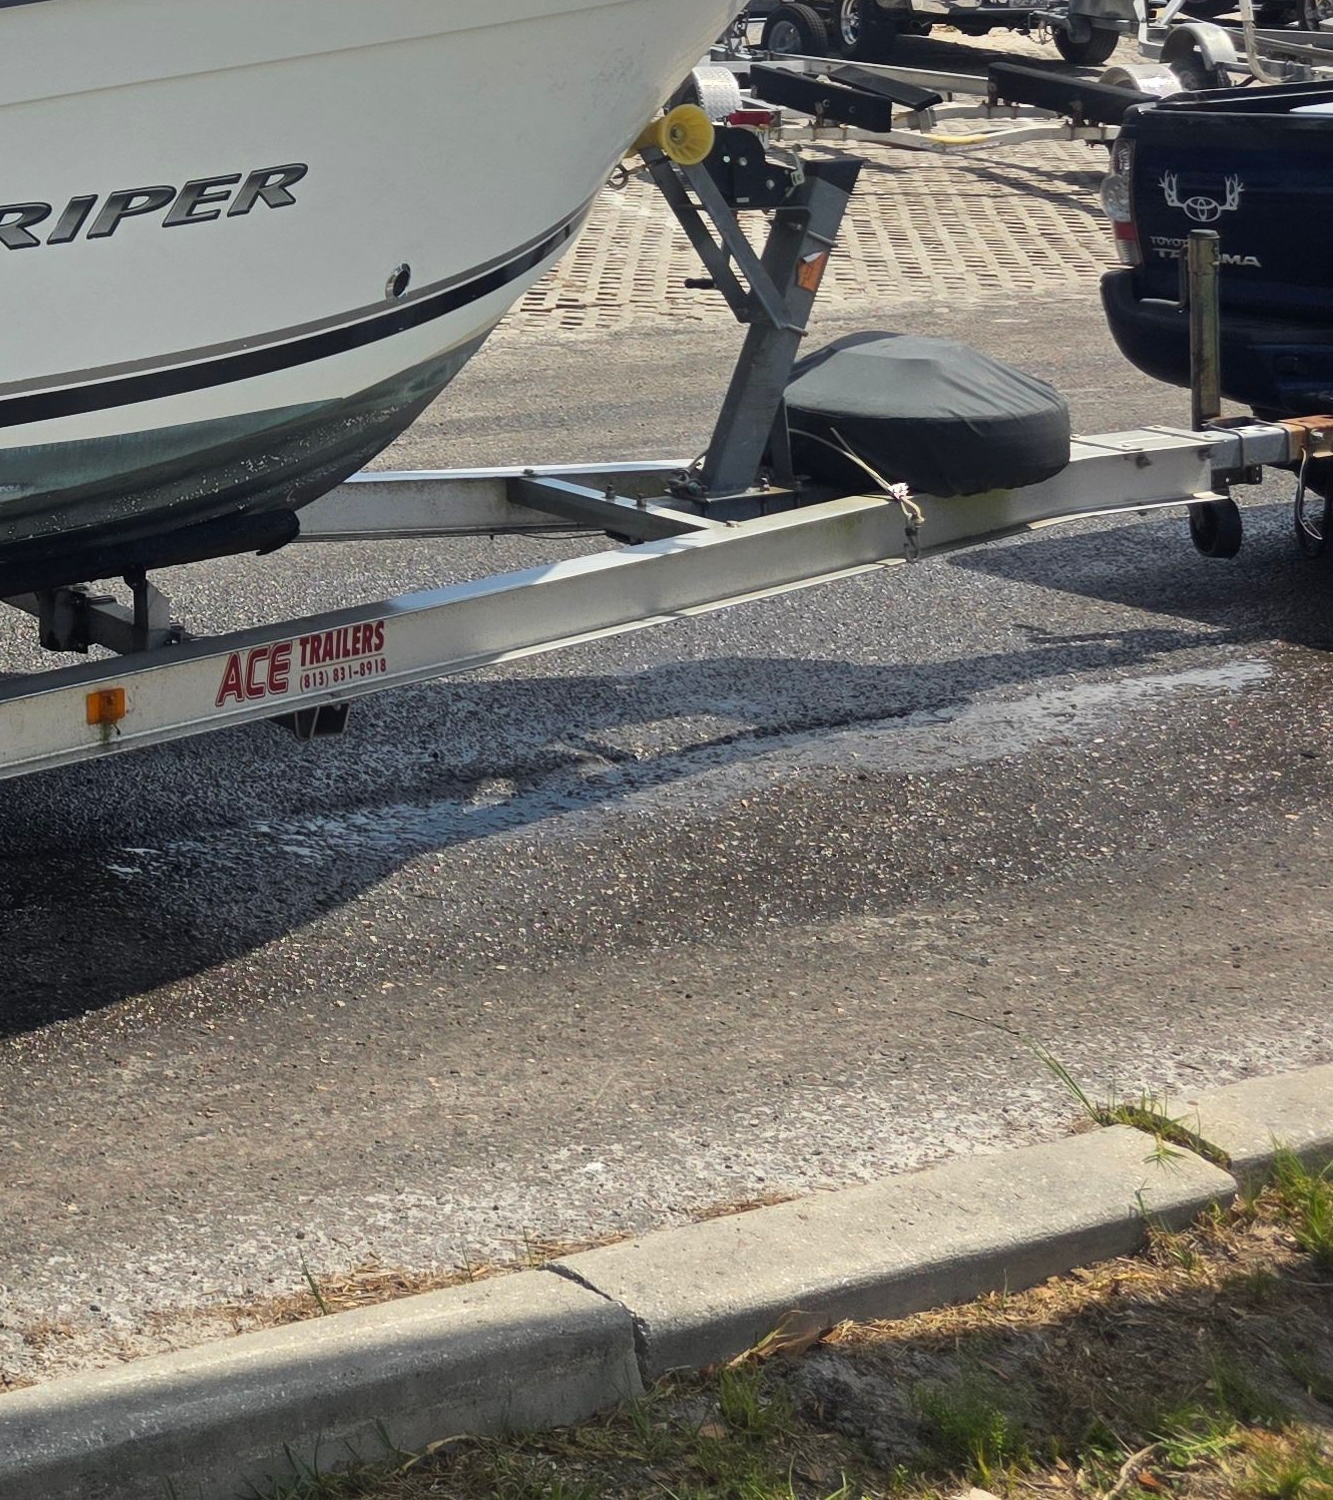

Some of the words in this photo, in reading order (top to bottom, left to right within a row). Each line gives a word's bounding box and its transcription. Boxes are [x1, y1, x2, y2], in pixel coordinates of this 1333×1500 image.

[1149, 235, 1190, 247] TOYOT
[1152, 247, 1262, 267] TAMA
[215, 639, 294, 707] ACE
[299, 620, 385, 667] TRAILERS
[299, 672, 329, 692] (813)
[333, 658, 387, 683] 831-8918
